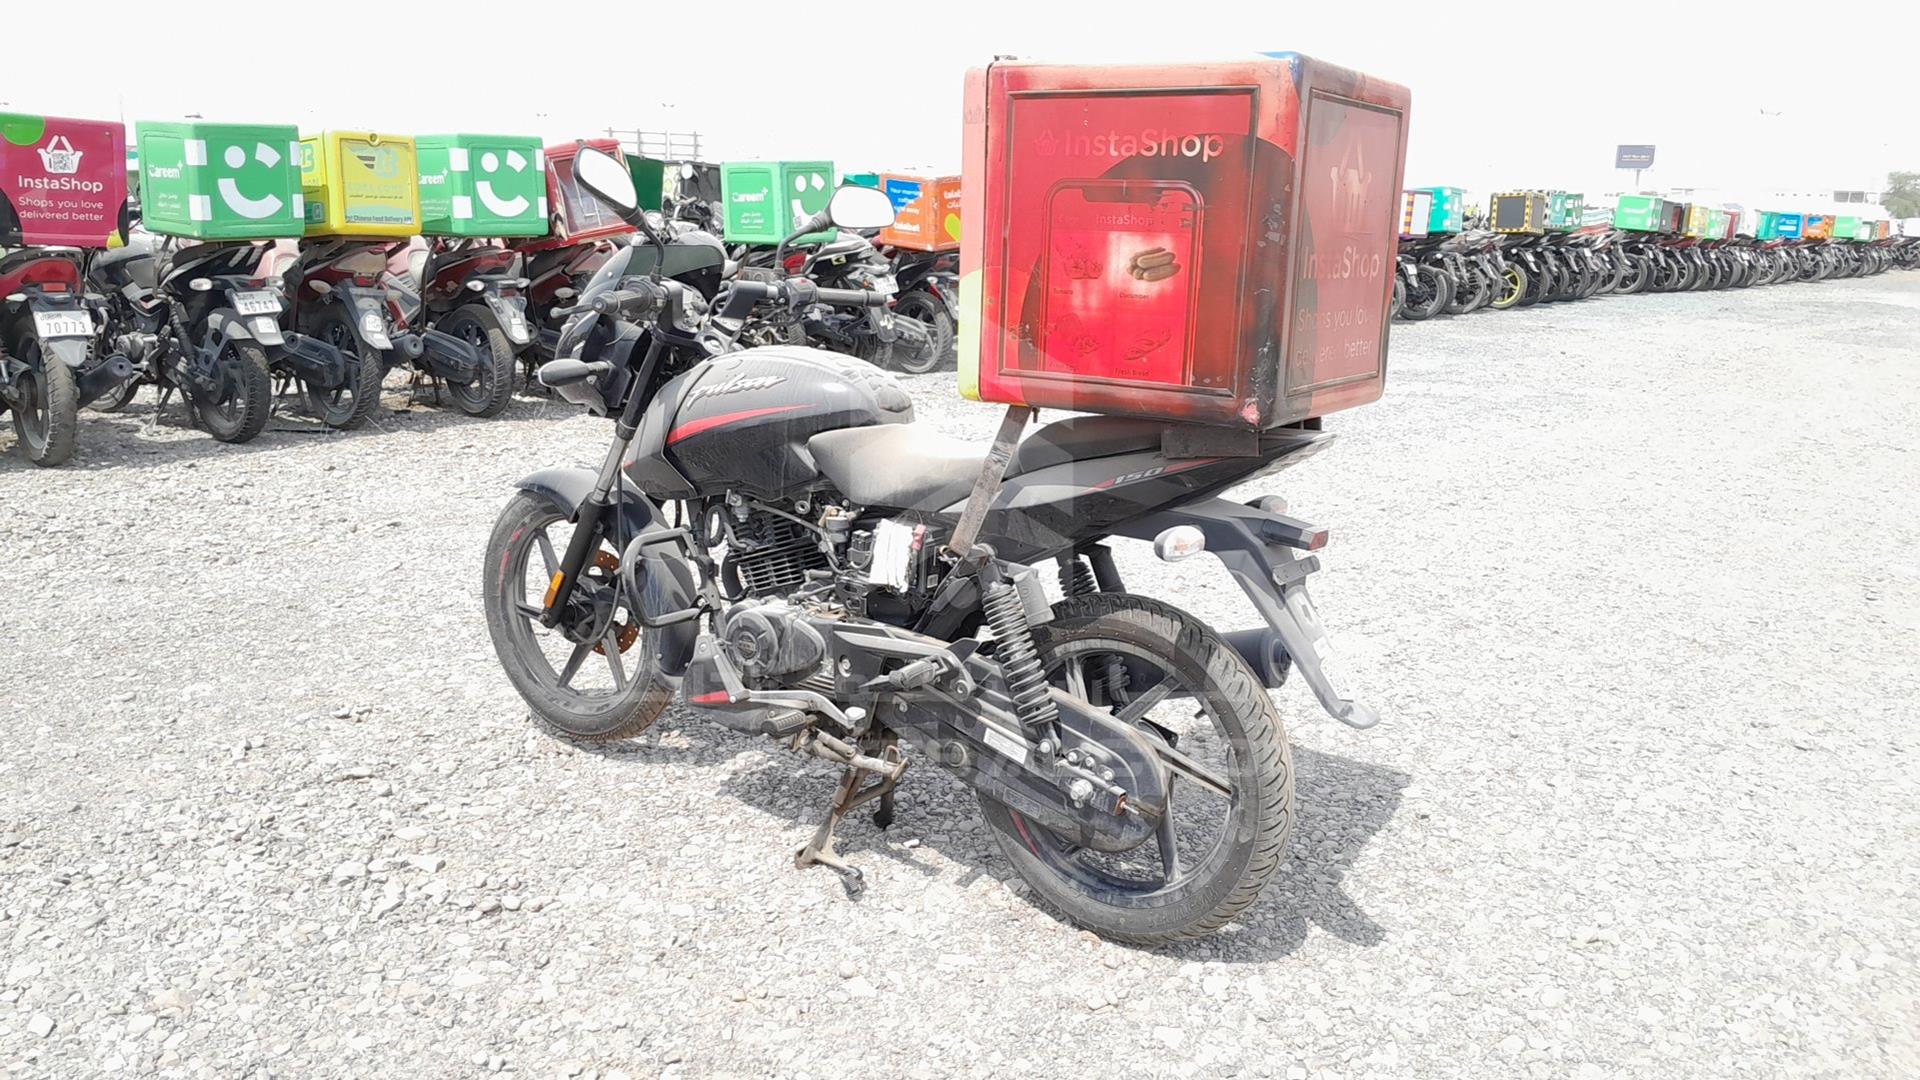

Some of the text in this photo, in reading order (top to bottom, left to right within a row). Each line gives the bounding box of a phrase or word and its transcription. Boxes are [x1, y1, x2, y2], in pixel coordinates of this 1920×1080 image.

[1065, 128, 1224, 163] InstaShop
[18, 175, 104, 194] InstaShop
[19, 197, 104, 209] Shops you love
[19, 210, 104, 221] delivered better
[1303, 246, 1381, 282] InaShop
[46, 321, 87, 335] 70773
[1298, 308, 1331, 332] Shs
[1334, 310, 1354, 333] you
[1344, 337, 1373, 359] better
[1115, 467, 1164, 485] 150
